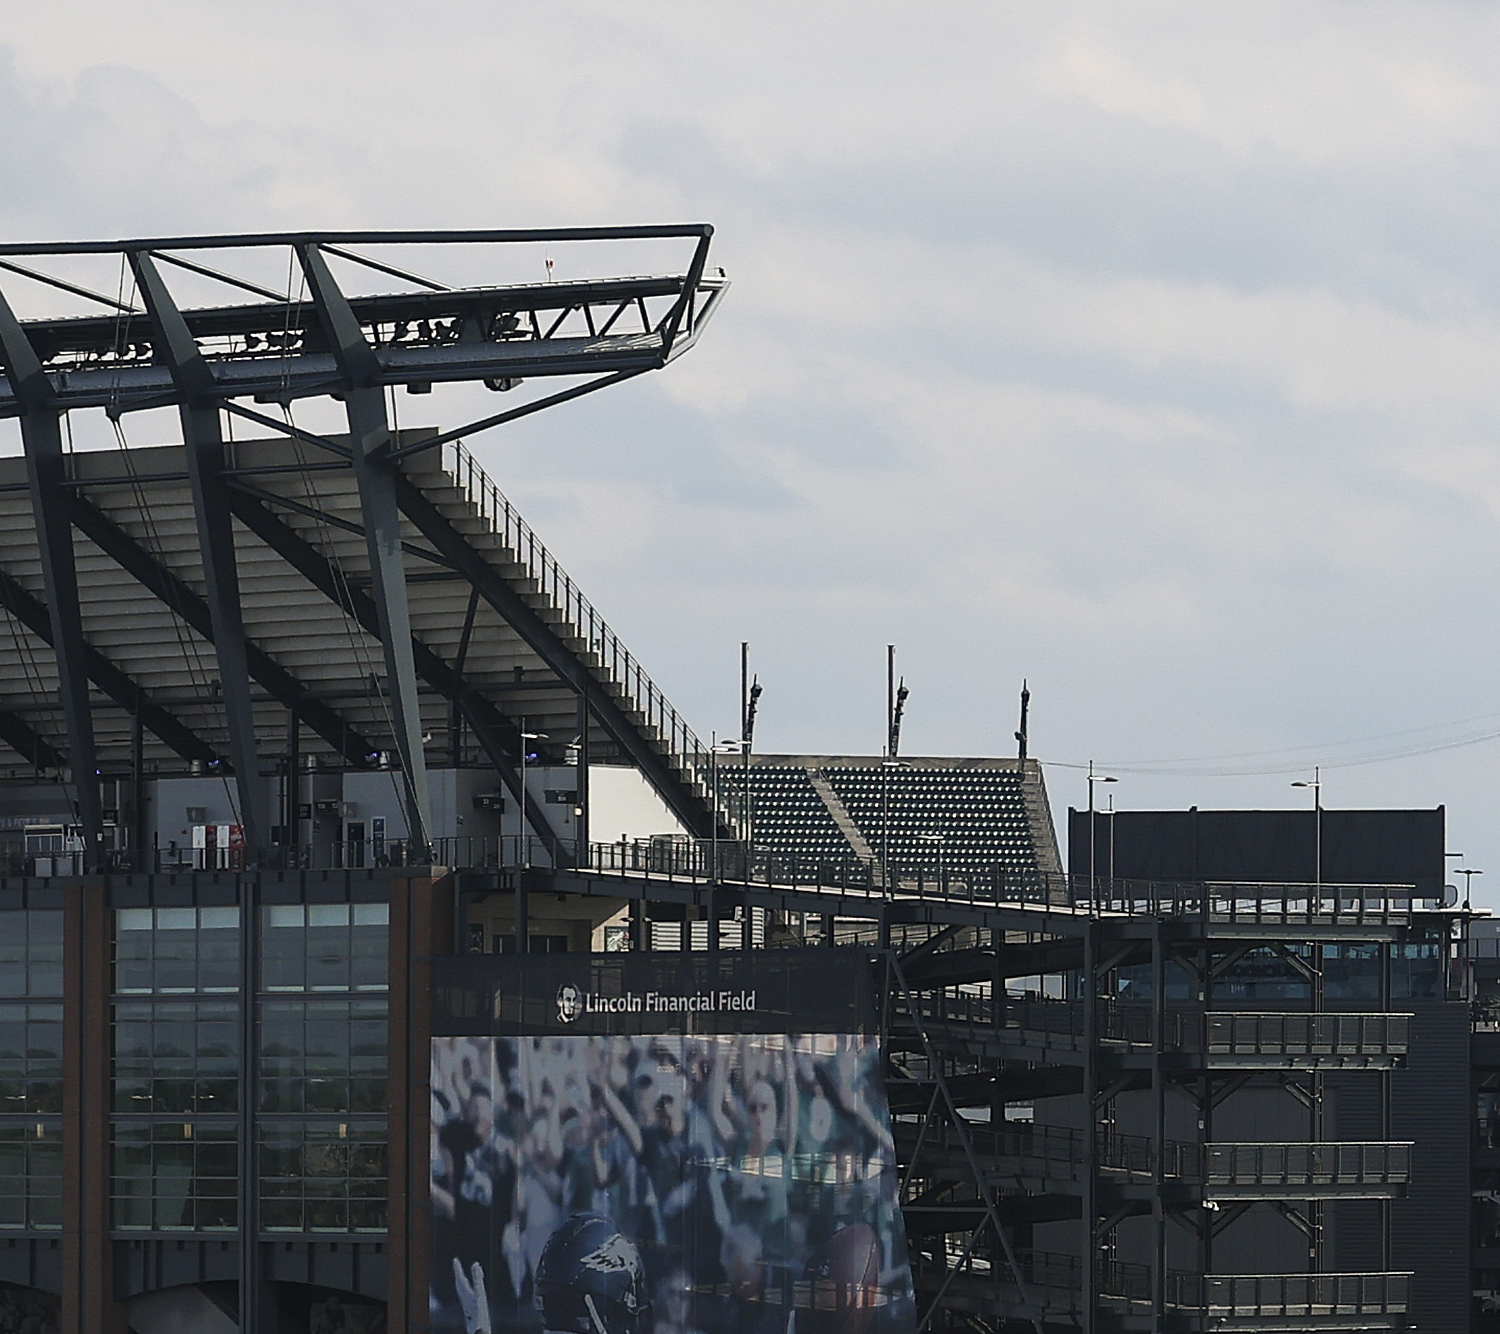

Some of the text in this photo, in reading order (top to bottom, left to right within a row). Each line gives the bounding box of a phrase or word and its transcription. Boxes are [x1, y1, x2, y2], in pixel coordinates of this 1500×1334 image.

[585, 990, 756, 1013] Lincoln Financial Field
